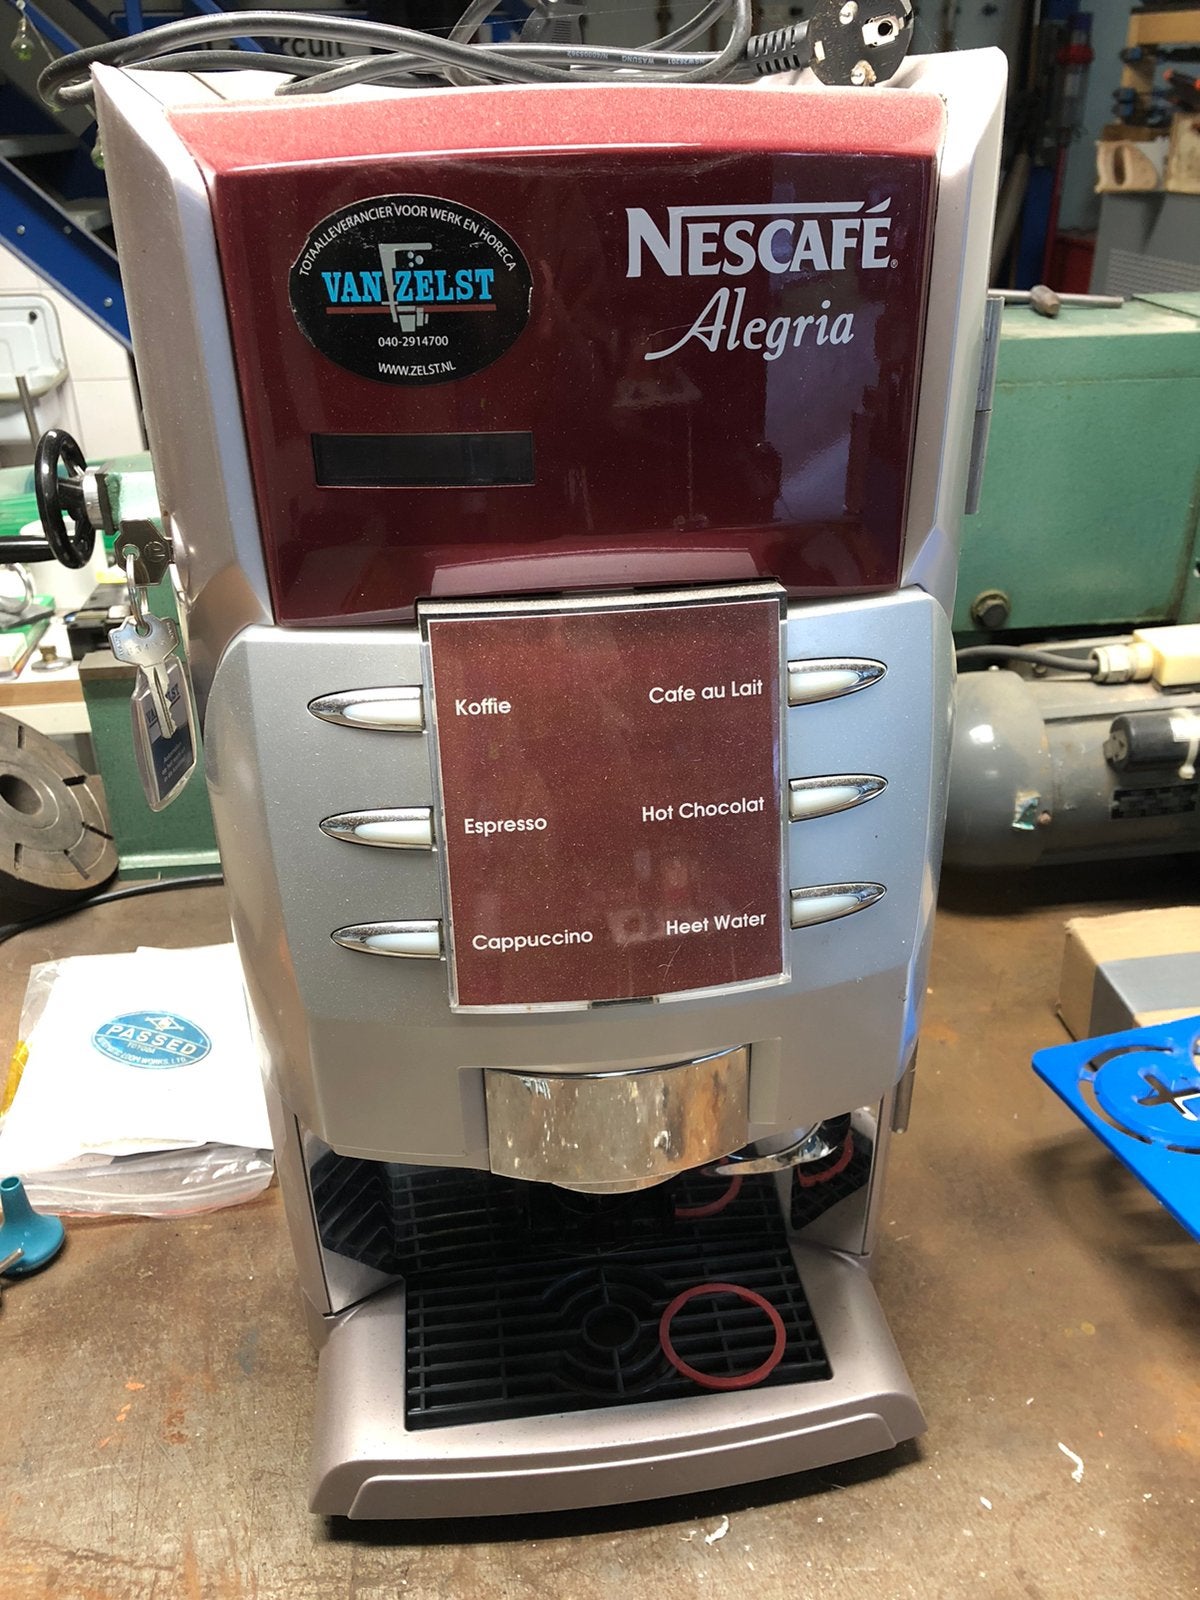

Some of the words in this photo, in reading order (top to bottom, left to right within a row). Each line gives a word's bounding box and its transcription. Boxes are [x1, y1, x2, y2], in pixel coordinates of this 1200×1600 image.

[299, 204, 394, 276] TOTAALLEVERANCIER
[394, 204, 428, 217] VOOR
[429, 207, 462, 227] WERK
[462, 217, 480, 234] EN
[479, 227, 517, 272] HORECA
[625, 197, 892, 278] NESCAFÉ
[321, 270, 383, 302] VAN
[394, 268, 495, 302] ZELST
[644, 286, 855, 361] Alegria
[378, 335, 449, 348] 040-2914700
[378, 360, 456, 377] WWW.ZELST.NL
[649, 684, 696, 704] Cafe
[701, 685, 726, 700] au
[730, 679, 763, 698] Lait
[455, 698, 512, 716] Koffie
[641, 805, 674, 822] Hot
[678, 796, 765, 819] Chocolat
[464, 816, 547, 838] Espresso
[666, 918, 709, 936] Heet
[713, 911, 766, 932] Water
[472, 929, 594, 954] Cappuccino
[106, 1024, 198, 1056] PASSED
